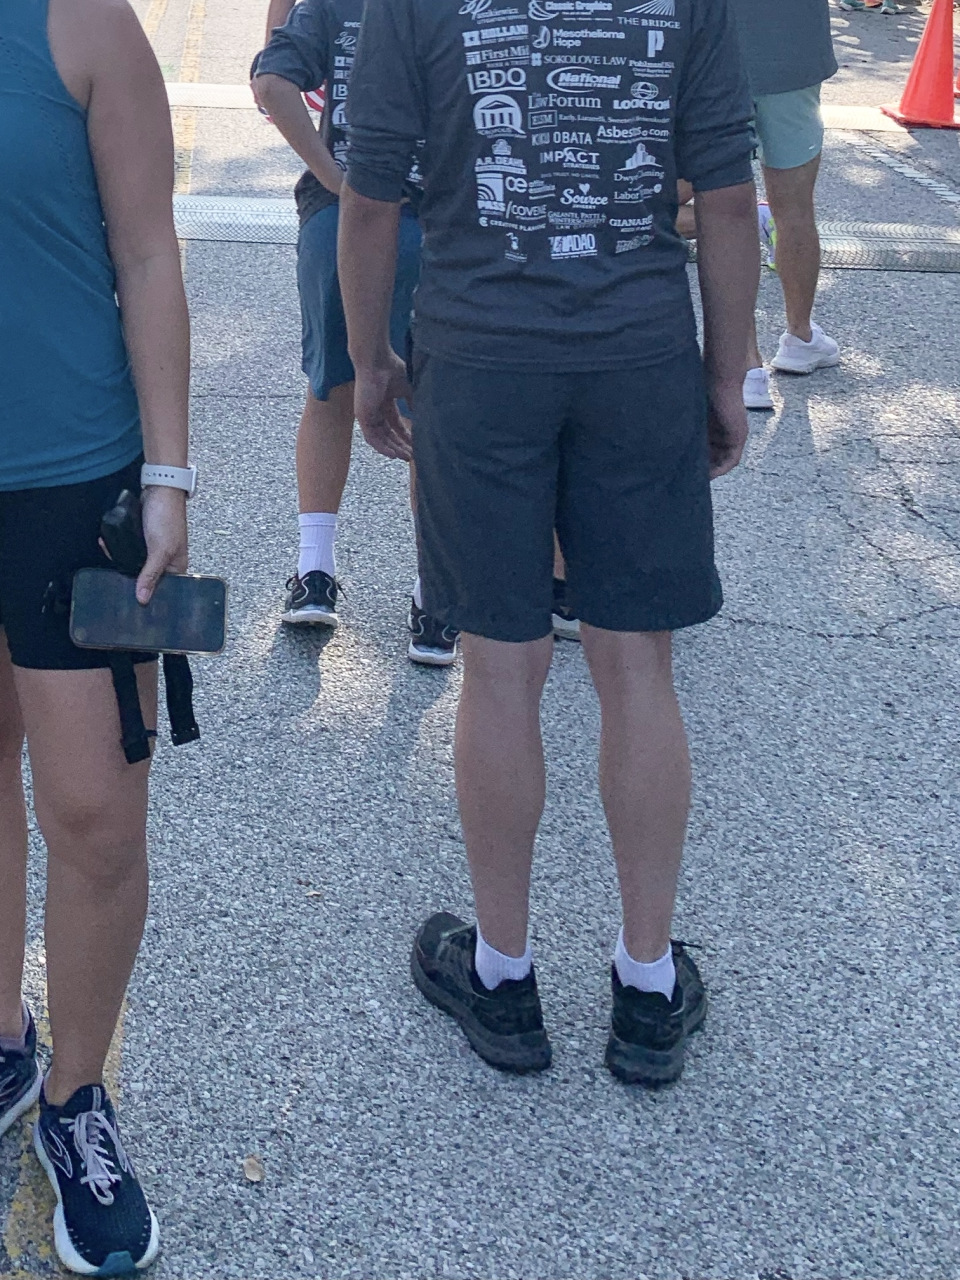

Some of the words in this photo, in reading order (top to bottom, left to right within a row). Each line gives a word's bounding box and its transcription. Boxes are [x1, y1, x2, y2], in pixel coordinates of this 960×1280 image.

[617, 16, 640, 26] THE
[641, 19, 682, 30] BRIDGE
[552, 28, 626, 39] Mesothelioma
[552, 38, 582, 48] Hope
[481, 48, 509, 61] First
[543, 55, 601, 65] SOKOLOVE
[602, 55, 627, 65] LAW
[558, 72, 621, 85] National
[553, 131, 593, 145] OBATA
[540, 148, 600, 164] IMPACT
[560, 188, 609, 206] Source
